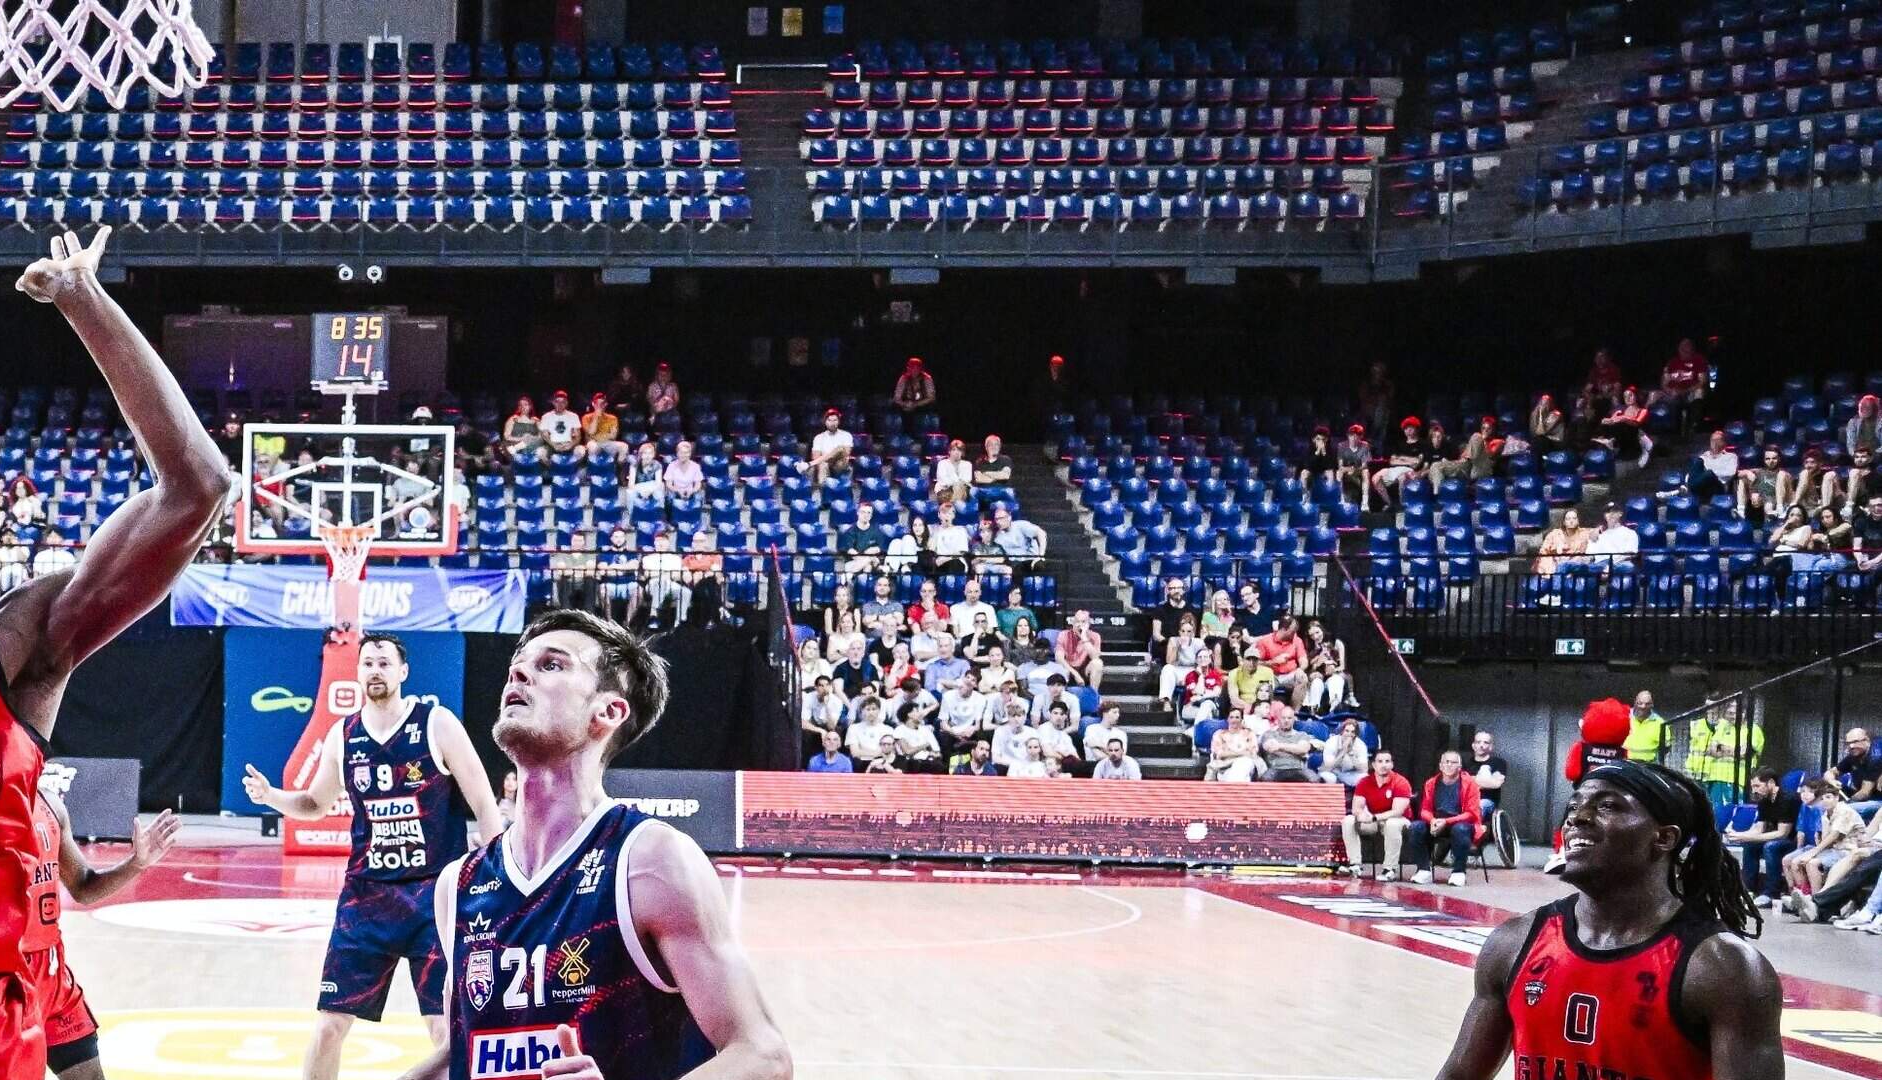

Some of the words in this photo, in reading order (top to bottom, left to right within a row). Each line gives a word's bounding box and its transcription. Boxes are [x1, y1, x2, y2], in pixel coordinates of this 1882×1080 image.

[339, 344, 373, 376] 14
[282, 581, 414, 617] CHAIONS
[376, 764, 393, 791] 9
[470, 880, 496, 895] CRAFT
[500, 944, 547, 1010] 21
[552, 985, 596, 998] PepperMill
[1564, 992, 1599, 1045] 0
